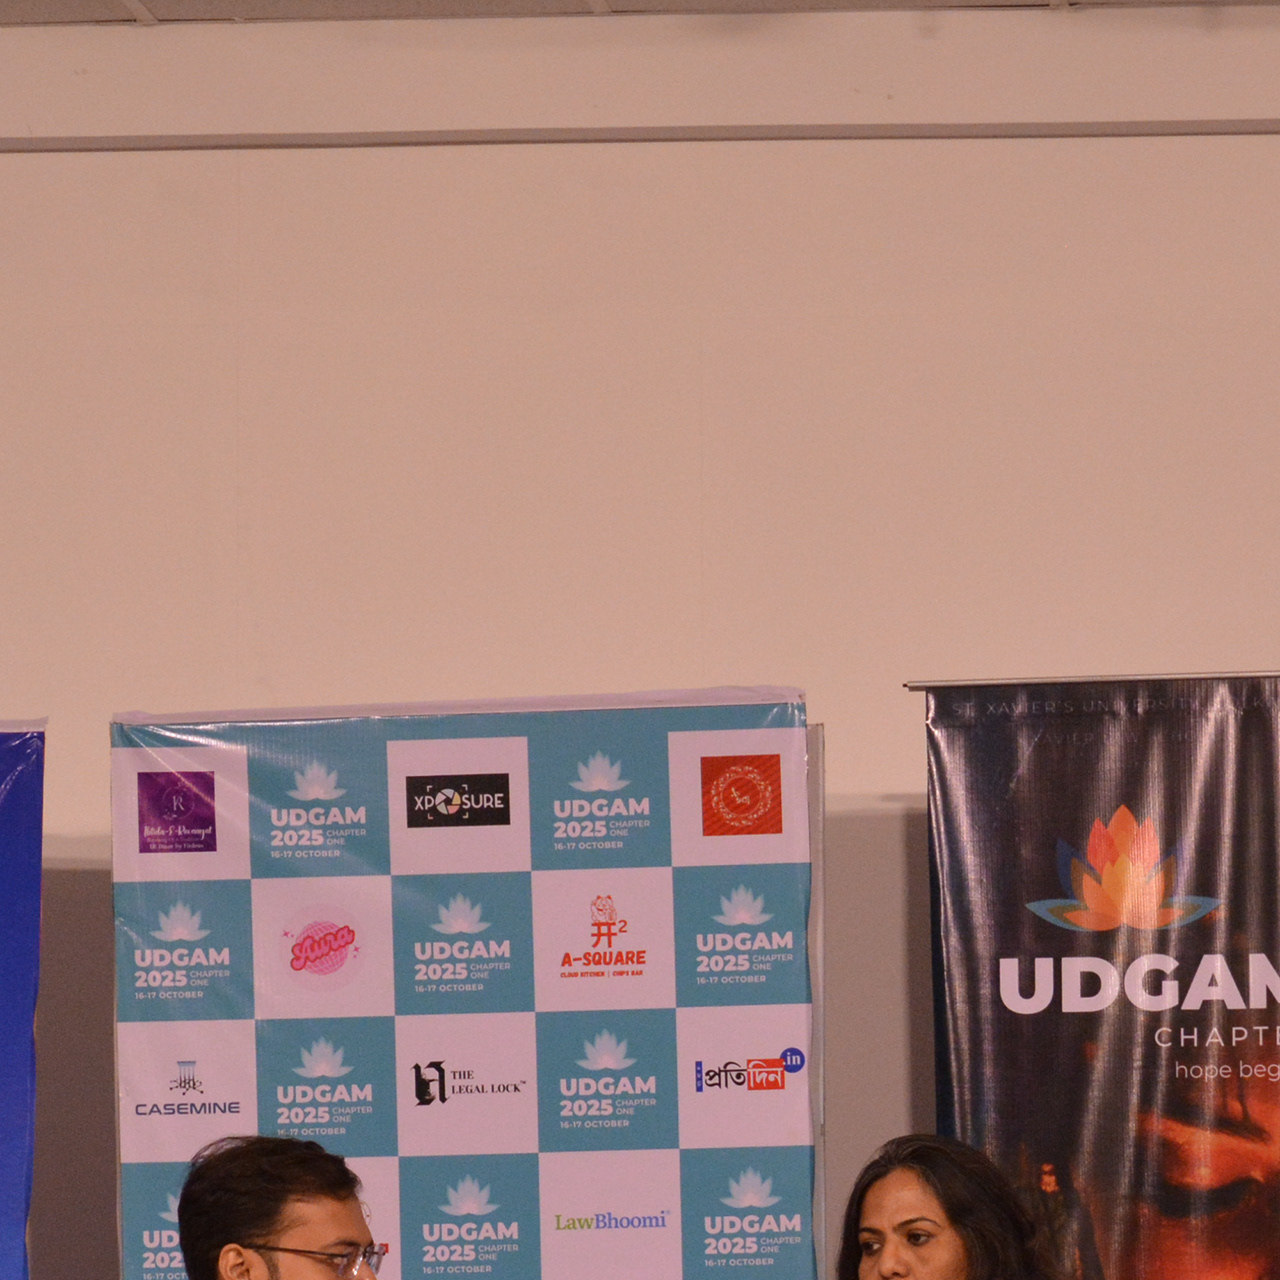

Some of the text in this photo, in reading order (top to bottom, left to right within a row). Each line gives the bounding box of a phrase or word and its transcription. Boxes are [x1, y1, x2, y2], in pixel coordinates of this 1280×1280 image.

[415, 940, 510, 960] UDGAM
[561, 950, 646, 967] A-SQUARE
[414, 962, 510, 980] 2025 CHAPTER
[470, 971, 489, 979] ONE
[439, 984, 484, 992] OCTOBER
[451, 1071, 474, 1079] THE
[1175, 1061, 1231, 1081] hope
[452, 1085, 488, 1094] LEGAL
[135, 1102, 240, 1115] CASEMINE
[555, 1210, 666, 1230] LawBhoomi
[705, 1214, 801, 1234] UDGAM
[704, 1237, 801, 1254] 2025 CHAPTER
[760, 1245, 779, 1253] ONE
[729, 1258, 774, 1266] OCTOBER
